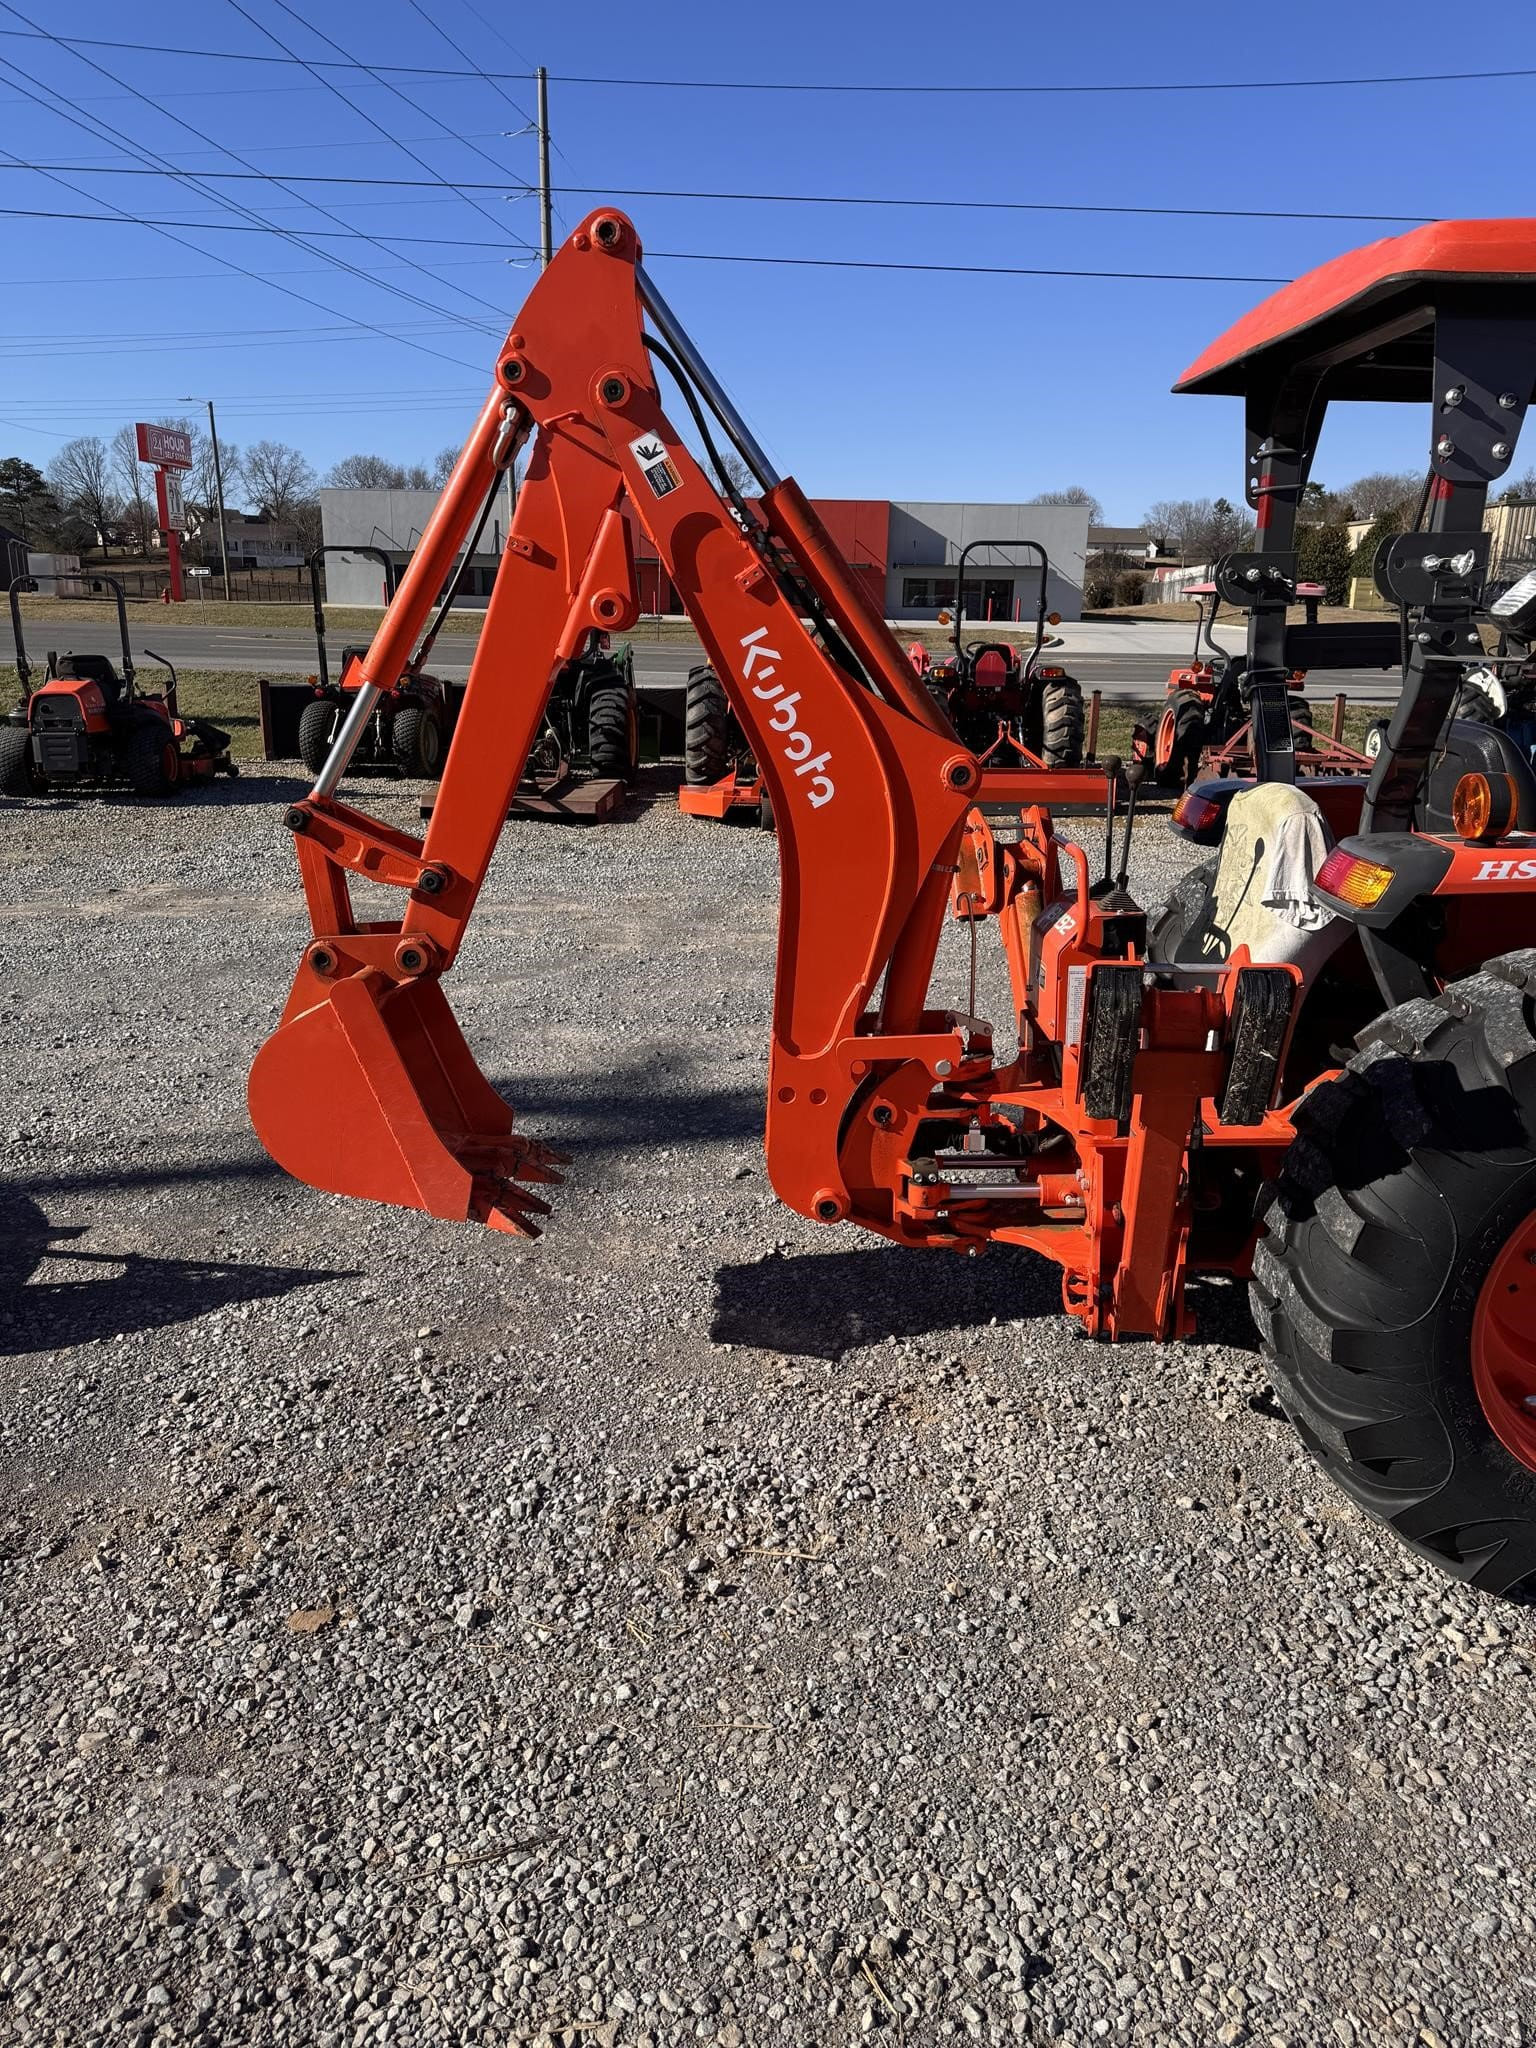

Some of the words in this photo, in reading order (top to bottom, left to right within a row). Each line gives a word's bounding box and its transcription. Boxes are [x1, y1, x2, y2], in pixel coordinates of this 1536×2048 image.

[152, 435, 163, 457] 24
[163, 435, 186, 453] HOUR
[739, 625, 835, 809] Kubota
[1471, 859, 1536, 881] HS
